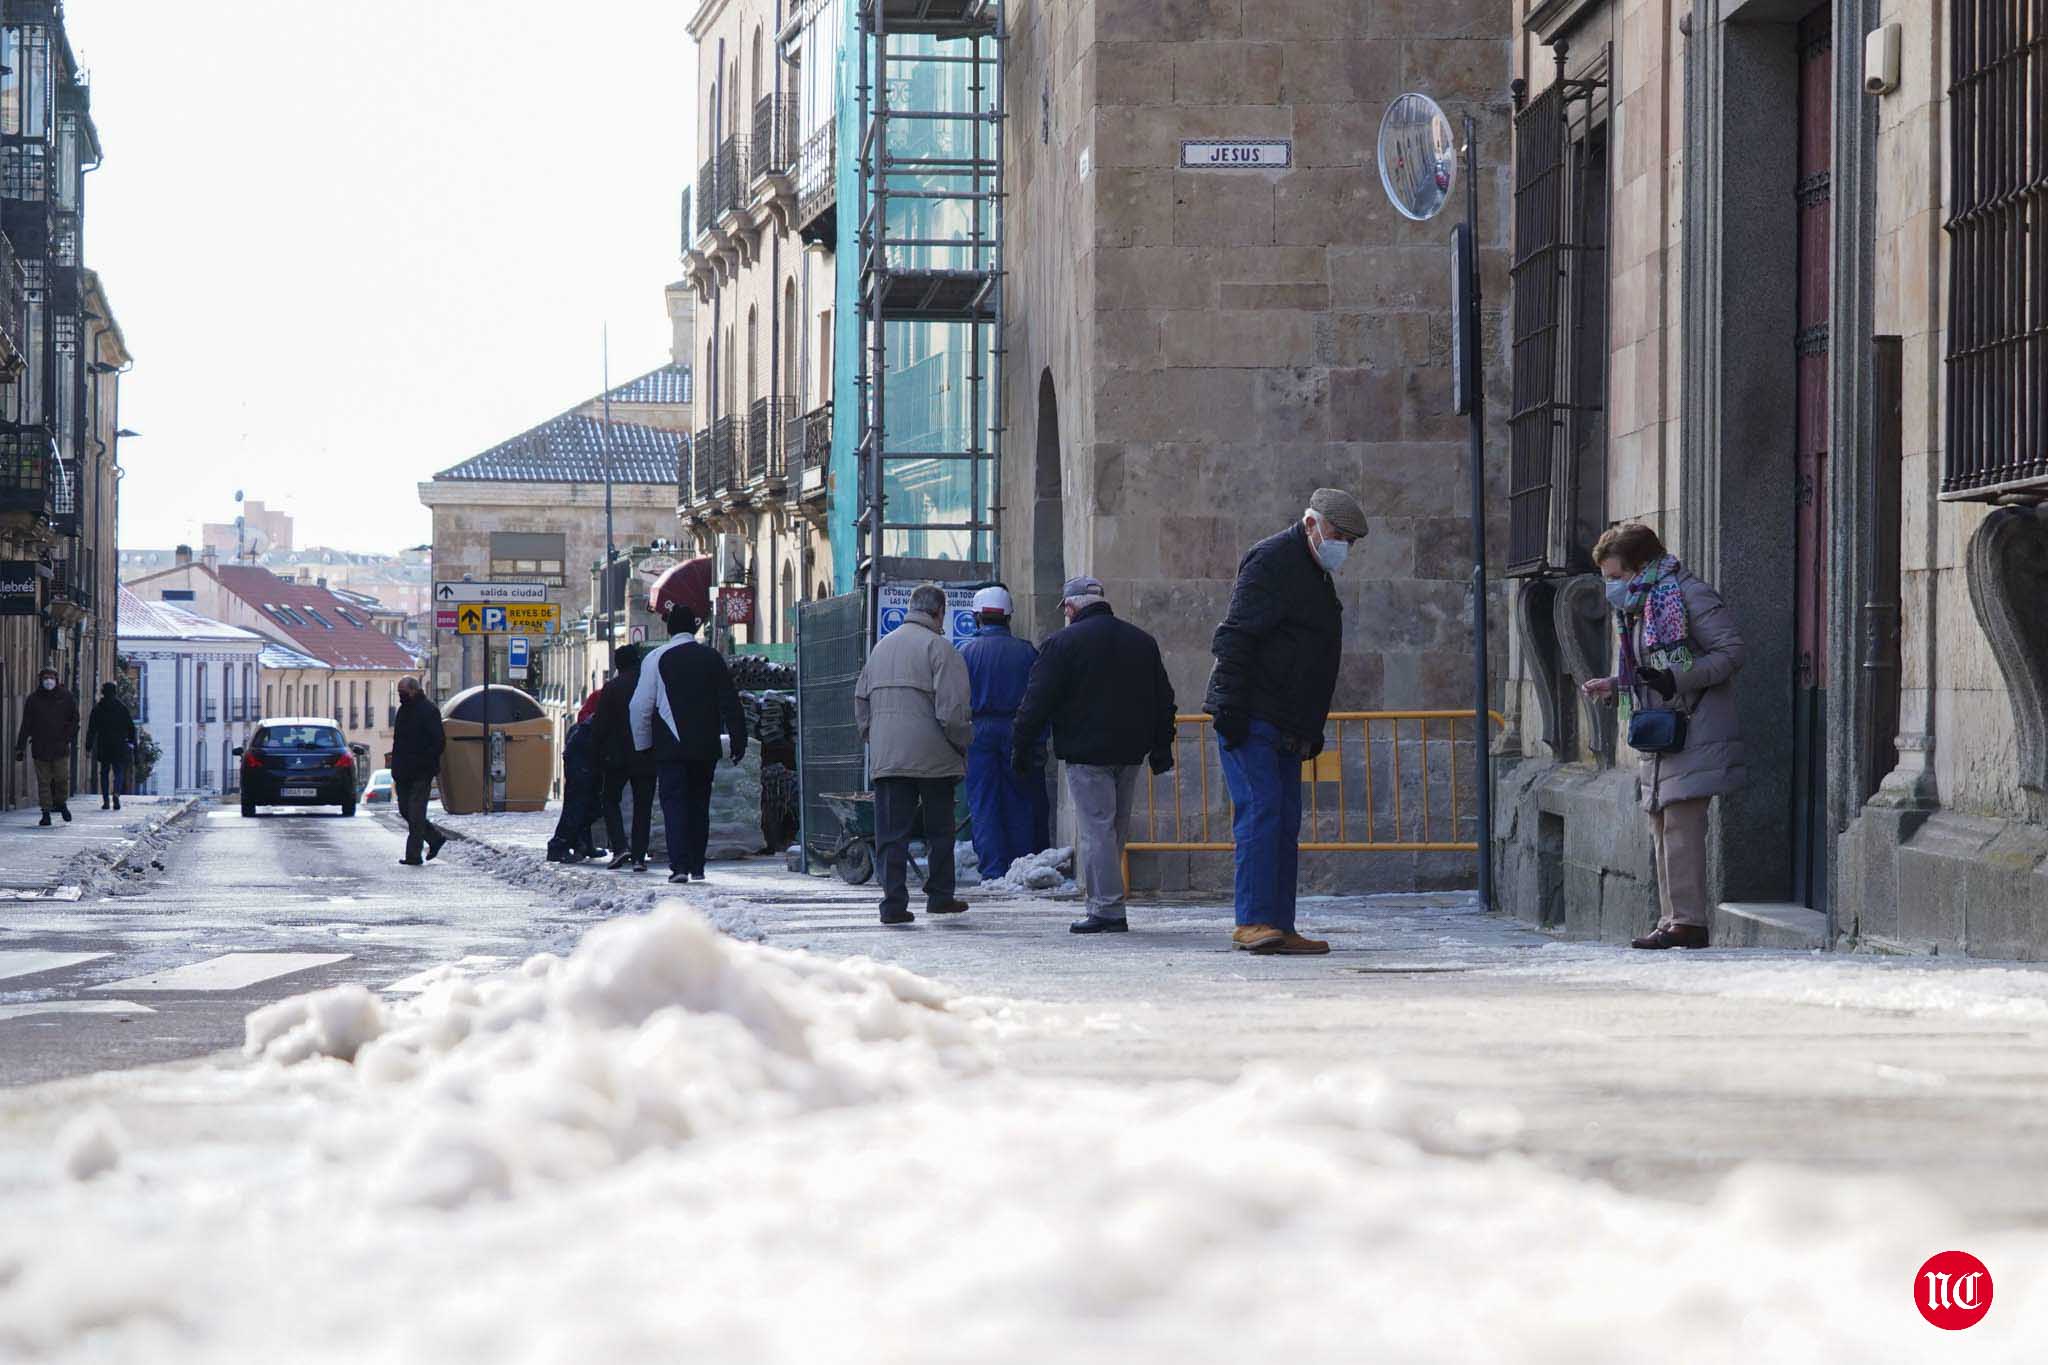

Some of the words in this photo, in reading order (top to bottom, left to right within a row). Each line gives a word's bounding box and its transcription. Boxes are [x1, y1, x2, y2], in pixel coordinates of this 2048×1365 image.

[1210, 147, 1261, 162] JESUS
[480, 588, 508, 597] salida
[512, 588, 543, 597] ciudad
[510, 609, 538, 617] REYES
[541, 608, 553, 617] DE
